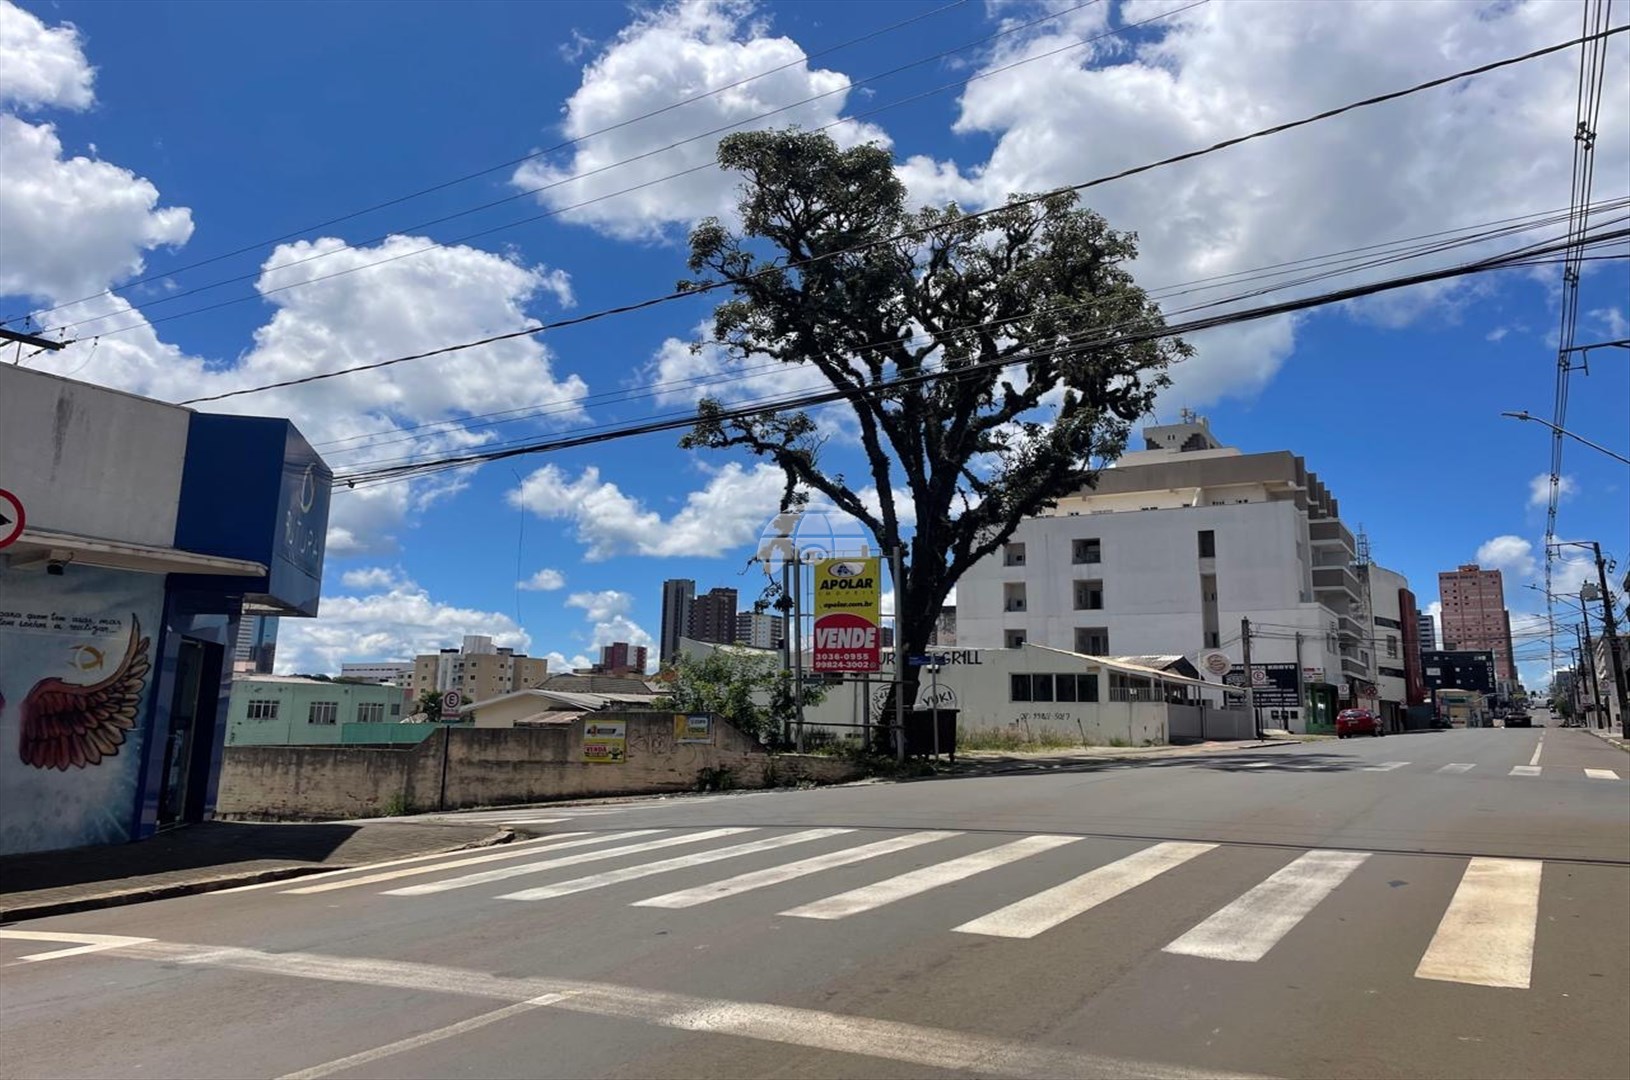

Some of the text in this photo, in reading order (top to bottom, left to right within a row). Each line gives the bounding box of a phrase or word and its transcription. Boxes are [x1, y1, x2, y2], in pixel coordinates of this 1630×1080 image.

[820, 578, 873, 590] APOLAR
[823, 601, 873, 609] apolar.com.br
[816, 627, 876, 649] VENDE
[943, 650, 983, 665] GRILL
[1486, 661, 1494, 688] HOTEL
[449, 695, 455, 705] E
[923, 690, 953, 707] YUKI
